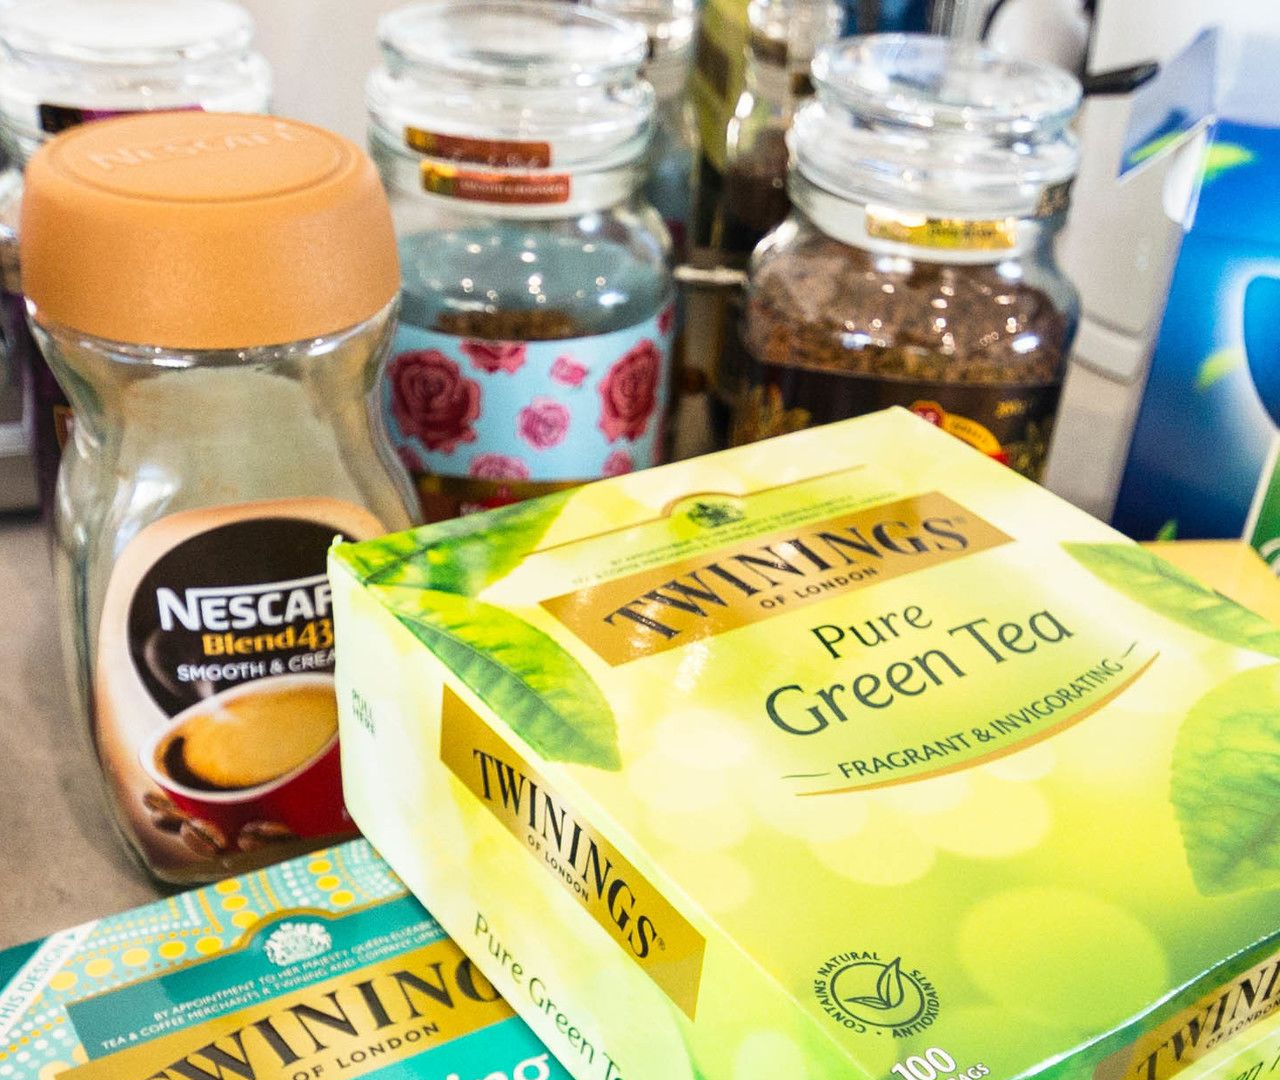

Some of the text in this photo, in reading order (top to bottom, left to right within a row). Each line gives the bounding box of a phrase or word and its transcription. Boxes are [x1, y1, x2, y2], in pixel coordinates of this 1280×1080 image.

[155, 571, 334, 632] NESCAF
[602, 515, 971, 641] TWININGS
[759, 565, 879, 611] OF LONDON
[176, 650, 337, 684] SMOOTH & CREA
[809, 604, 934, 660] Pure
[765, 608, 1076, 737] Green Tea
[837, 656, 1125, 780] FRAGRANT & INVIGORATING
[472, 748, 658, 961] TWININGS
[526, 833, 591, 905] OF LONDON
[100, 1035, 128, 1051] TEA
[128, 1031, 140, 1042] &
[139, 1016, 186, 1038] COFFEE
[187, 990, 261, 1022] MERCHANTS
[274, 968, 329, 992] TWINING
[329, 958, 356, 973] AND
[153, 1009, 169, 1023] BY
[171, 980, 256, 1016] APPOINTMENT
[278, 965, 302, 979] HER
[302, 949, 350, 971] MAJESTY
[474, 911, 525, 982] Pure
[528, 975, 597, 1067] Green
[813, 950, 941, 1039] CONTAINS NATURAL ANTIOXIDANTS
[336, 1021, 443, 1069] LONDON
[1204, 1032, 1225, 1050] OF
